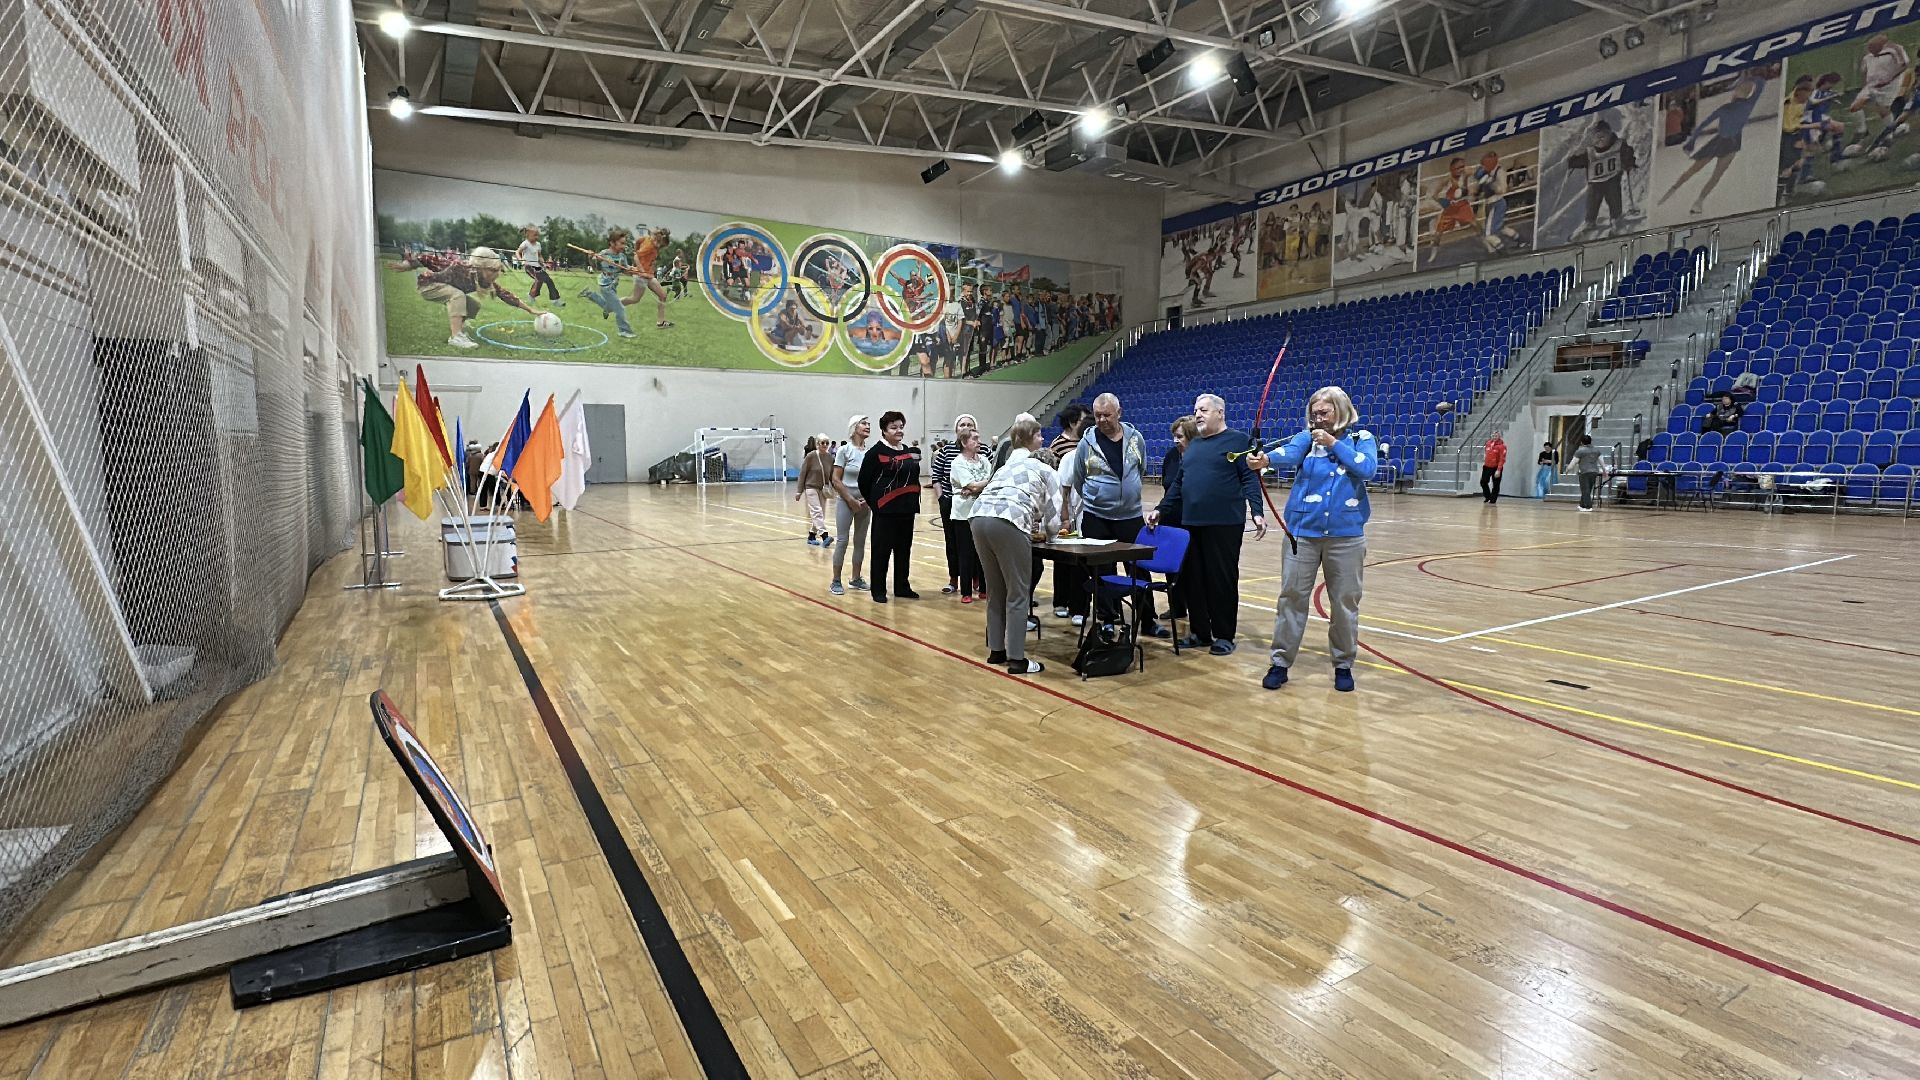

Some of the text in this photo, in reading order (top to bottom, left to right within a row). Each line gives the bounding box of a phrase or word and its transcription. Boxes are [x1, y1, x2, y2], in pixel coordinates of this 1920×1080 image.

[1257, 132, 1467, 205] ЗДОРОВЫЕ
[1480, 83, 1625, 143] ДЕТИ
[1701, 0, 1920, 75] КРЕП
